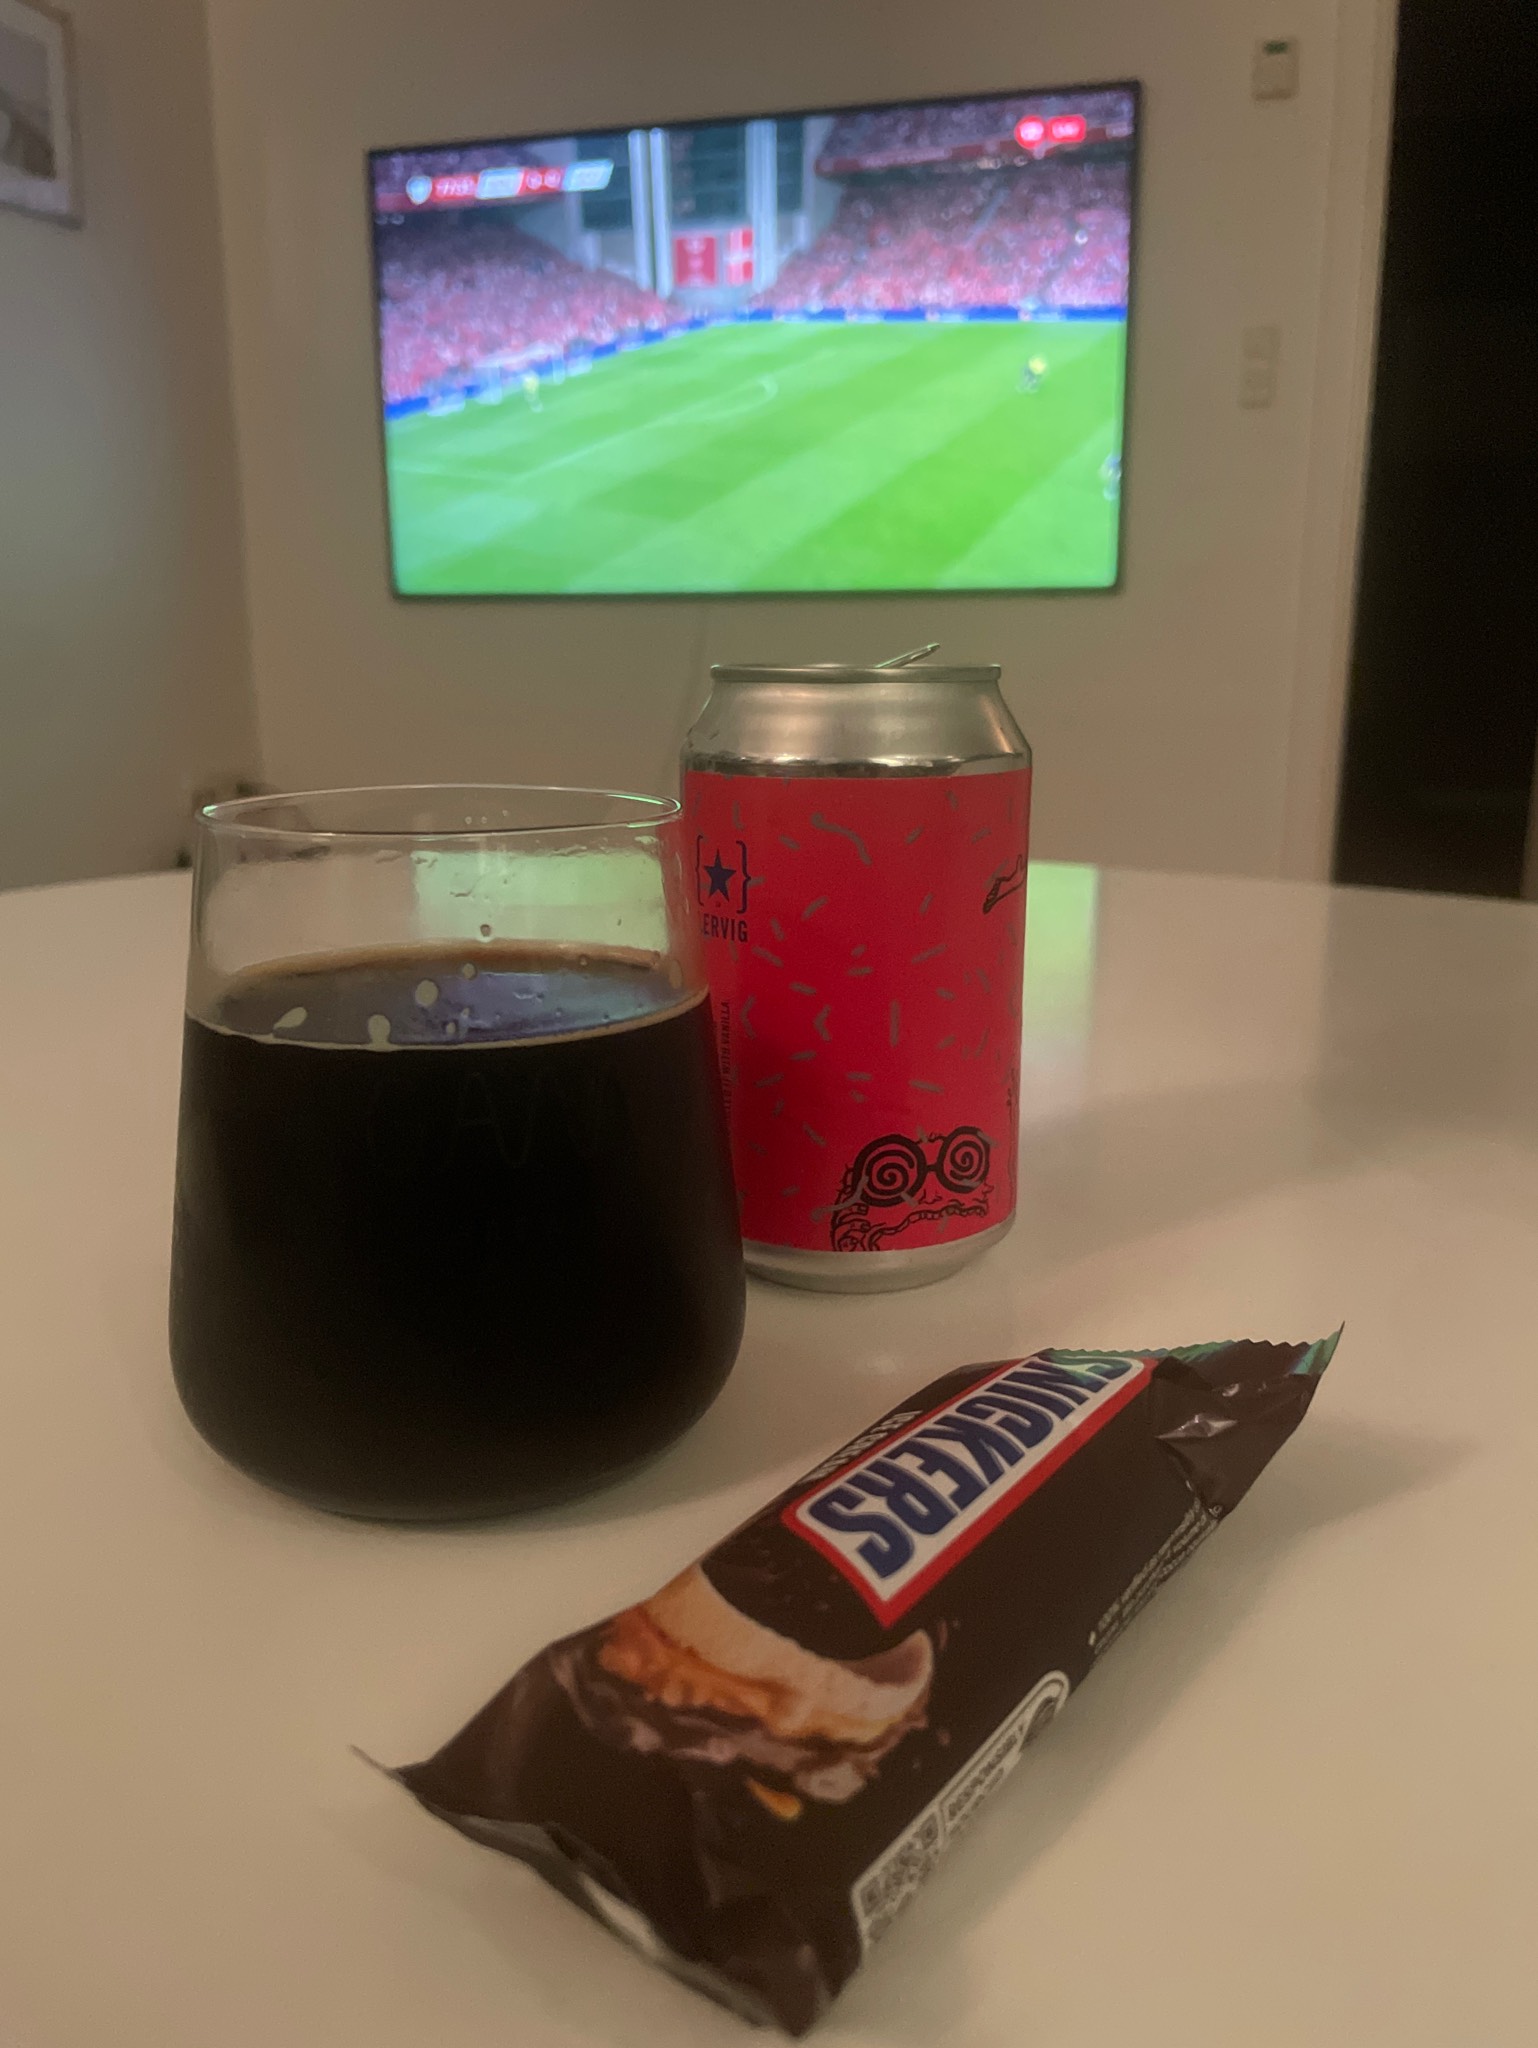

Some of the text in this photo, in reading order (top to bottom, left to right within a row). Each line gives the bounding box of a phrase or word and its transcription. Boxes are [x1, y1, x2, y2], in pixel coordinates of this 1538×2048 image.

[703, 913, 749, 943] ERVIG
[720, 1001, 731, 1045] VANILLA
[807, 1355, 1137, 1580] SNICKERS
